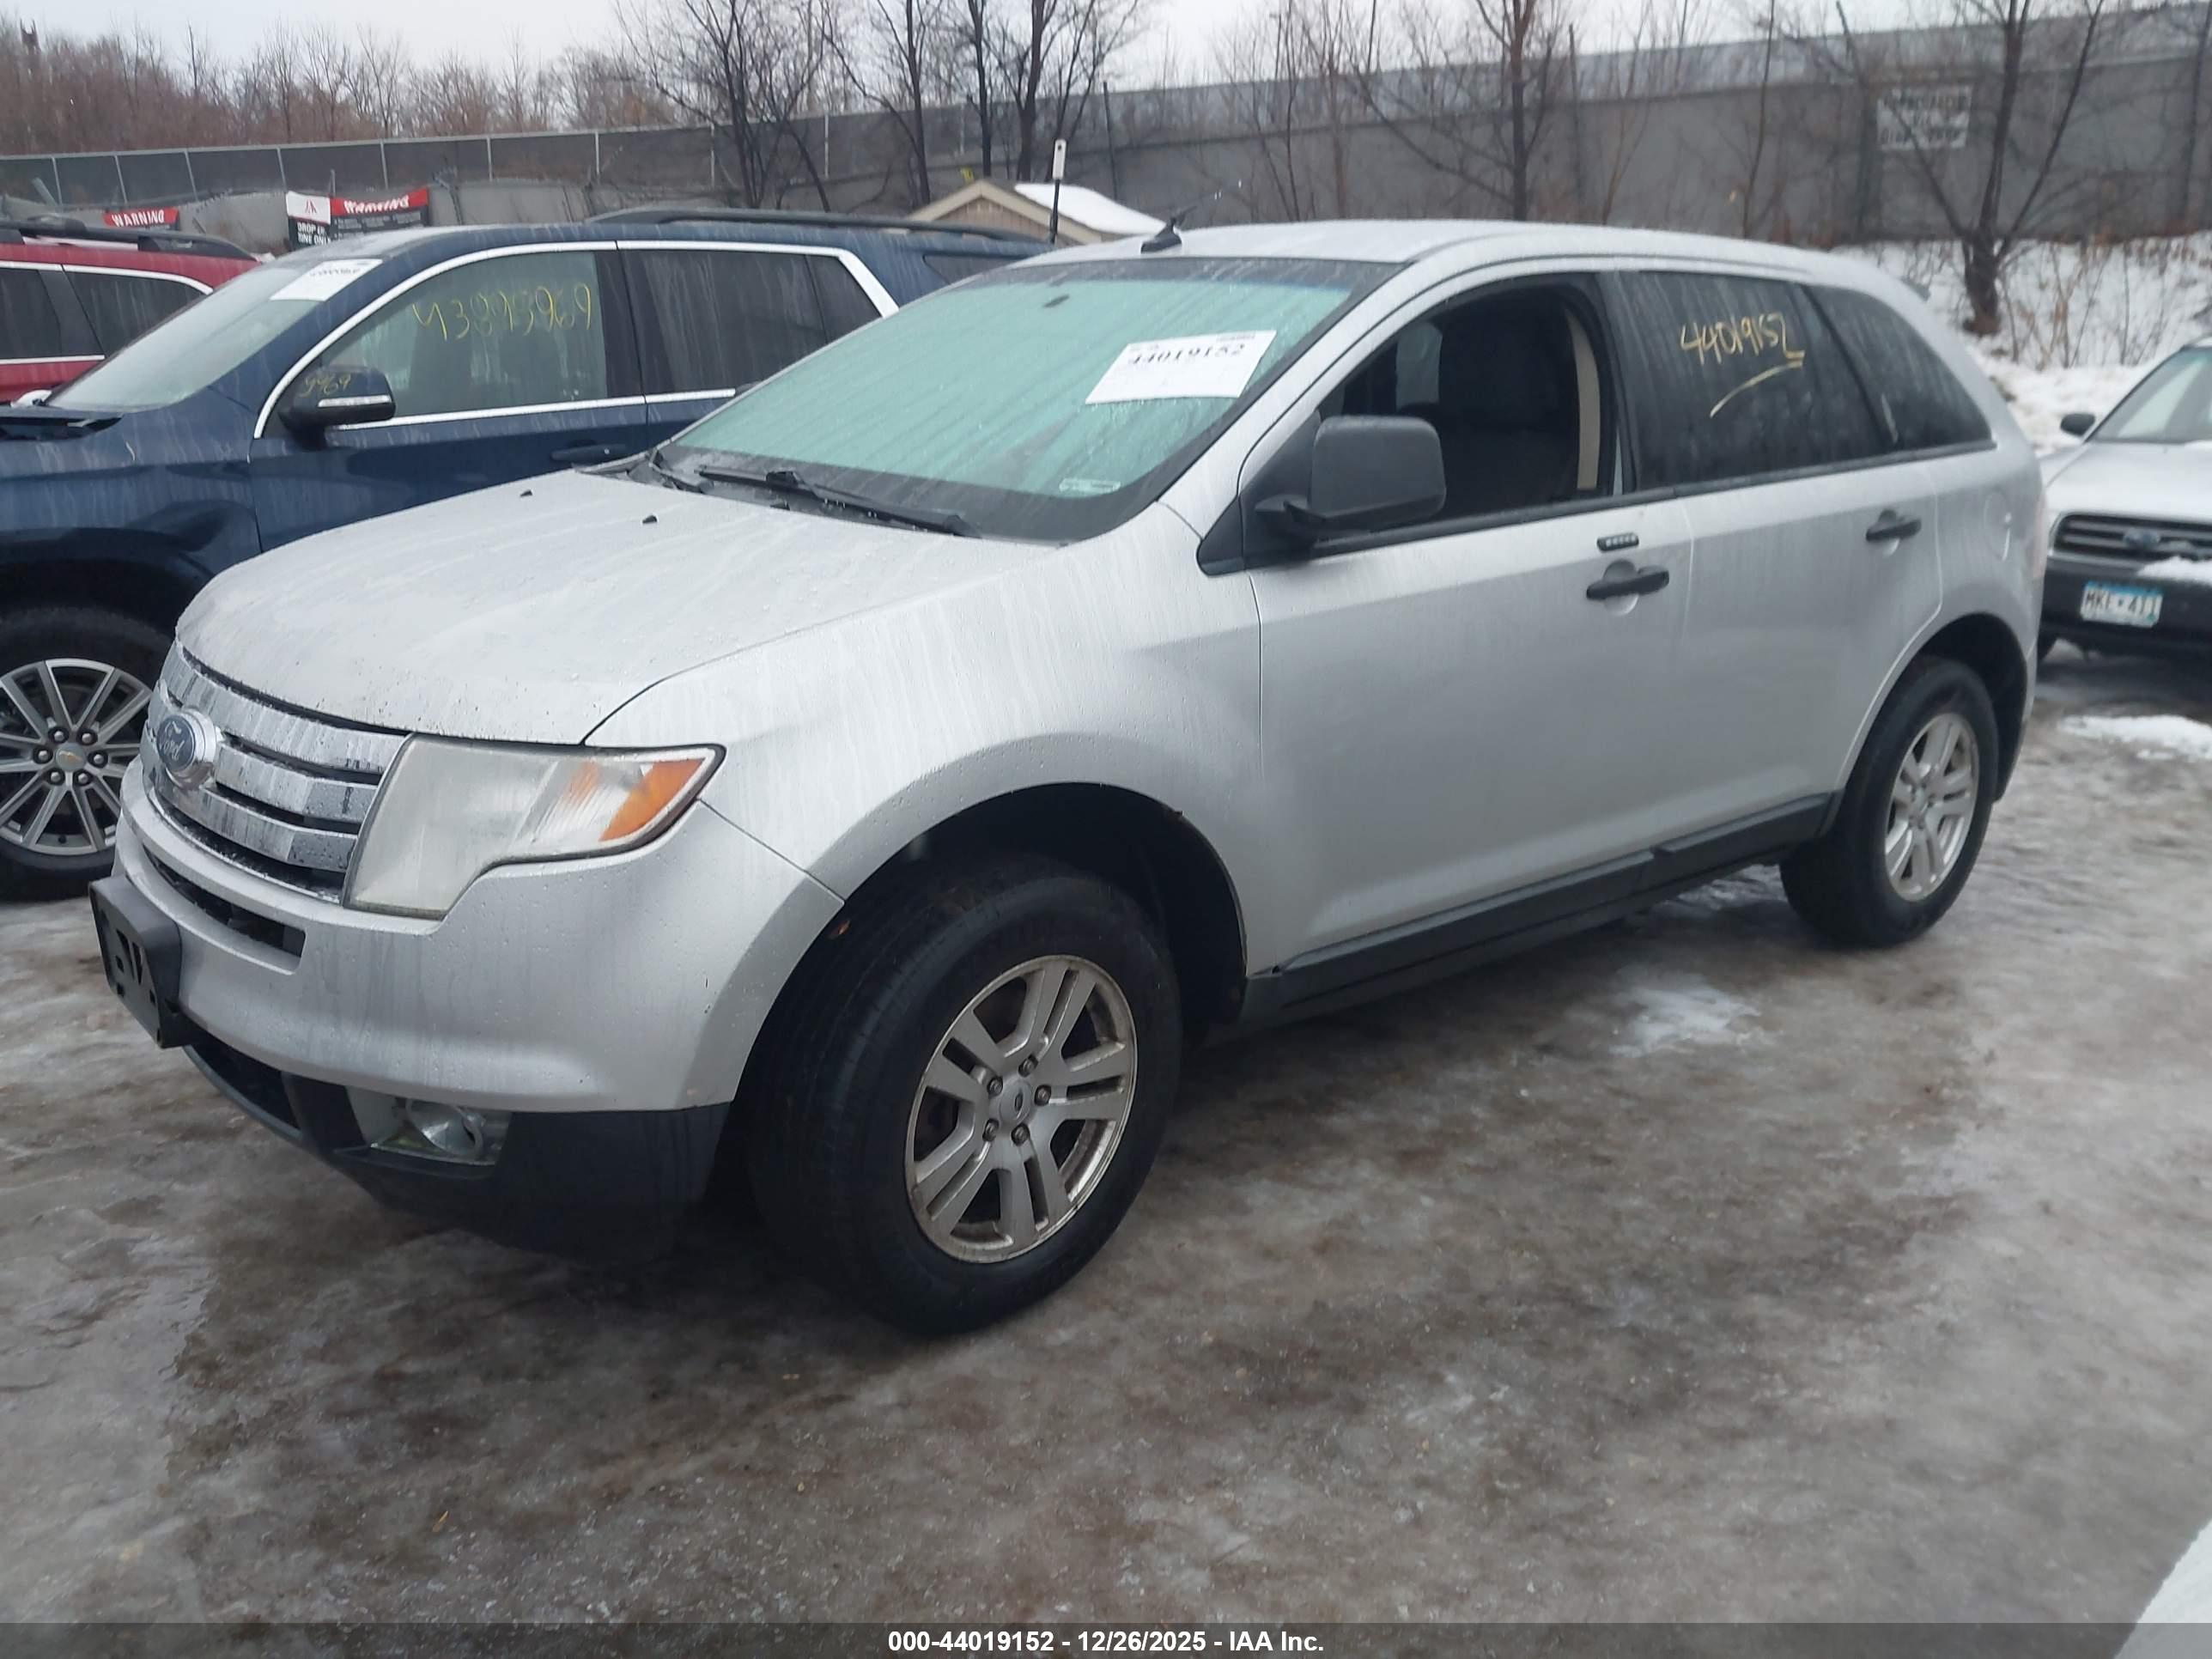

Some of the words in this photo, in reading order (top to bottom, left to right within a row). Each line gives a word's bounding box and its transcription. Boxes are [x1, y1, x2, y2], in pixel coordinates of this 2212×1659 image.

[345, 194, 410, 214] WARNING
[112, 209, 165, 228] WARNING
[297, 222, 317, 234] DROP
[1680, 311, 1805, 366] 44019152
